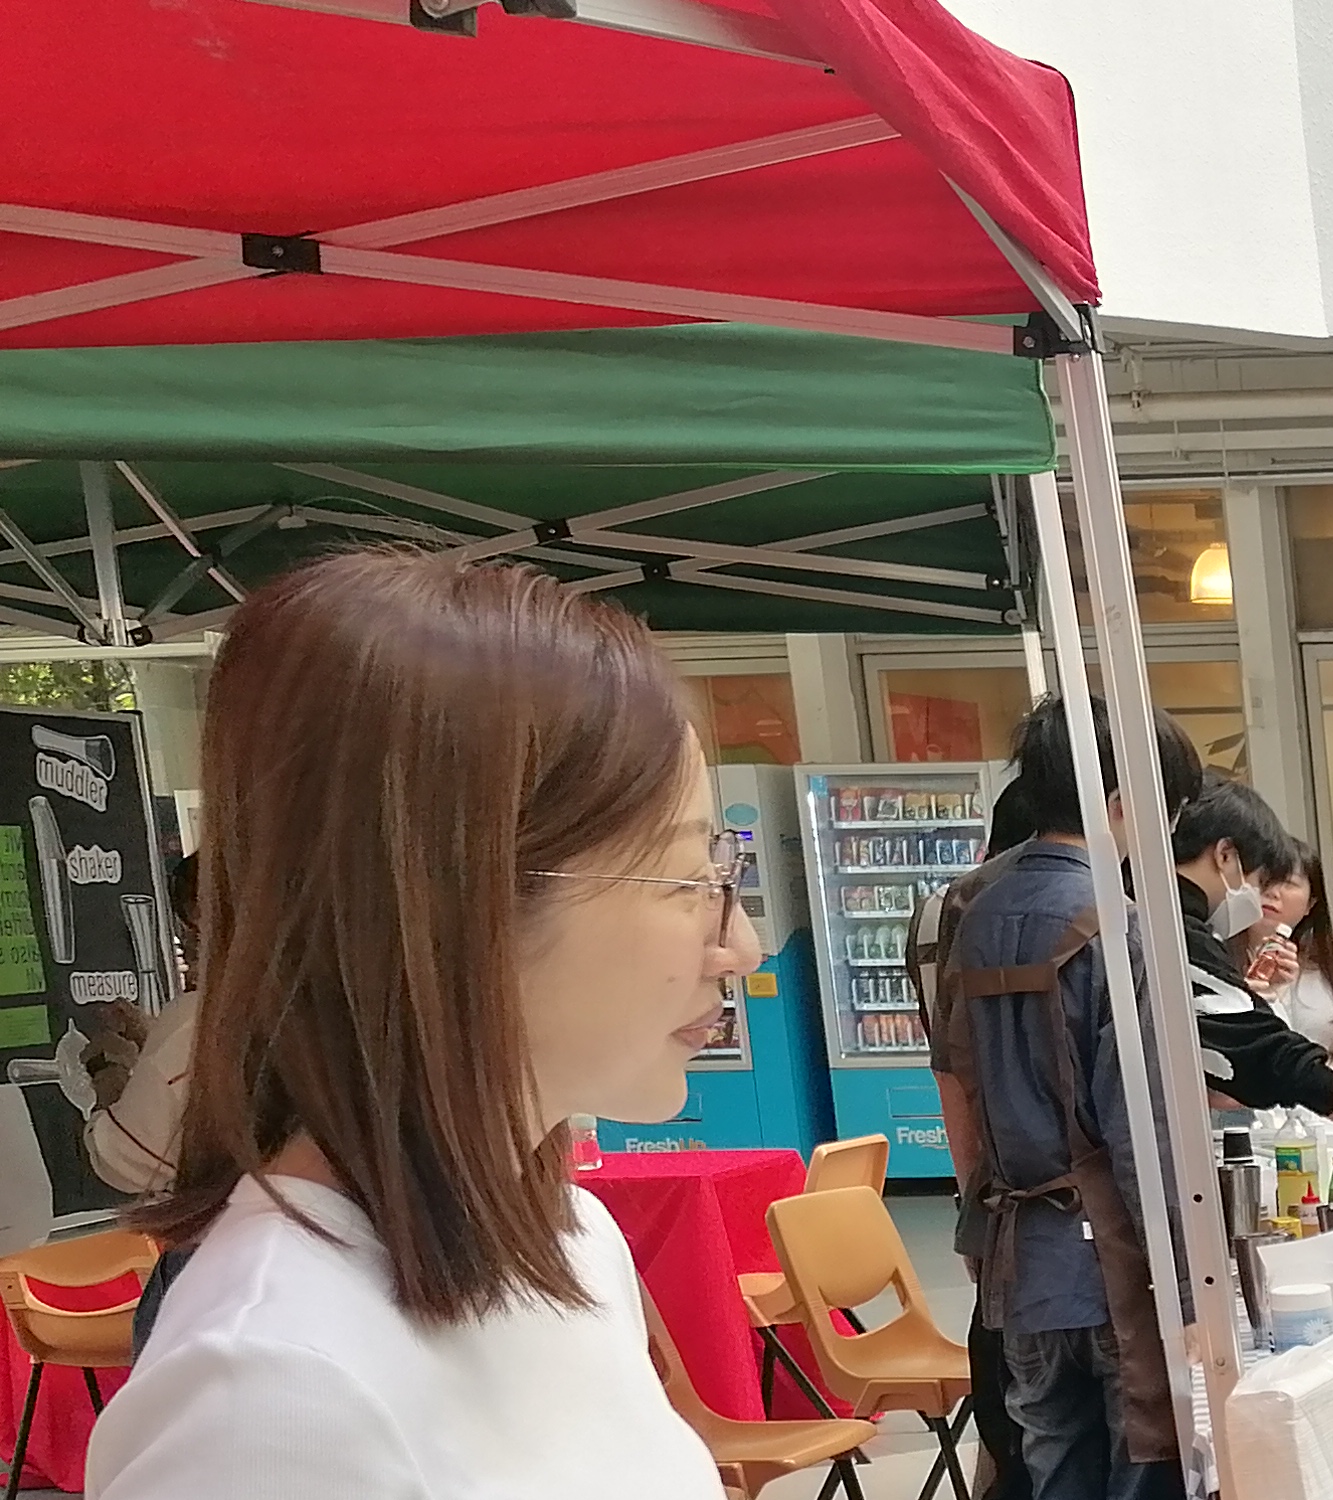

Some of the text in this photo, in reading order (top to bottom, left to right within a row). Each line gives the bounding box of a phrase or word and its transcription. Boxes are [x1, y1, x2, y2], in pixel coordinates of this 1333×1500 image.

[39, 757, 105, 804] muddler
[70, 849, 119, 880] shaker
[72, 974, 137, 997] measure
